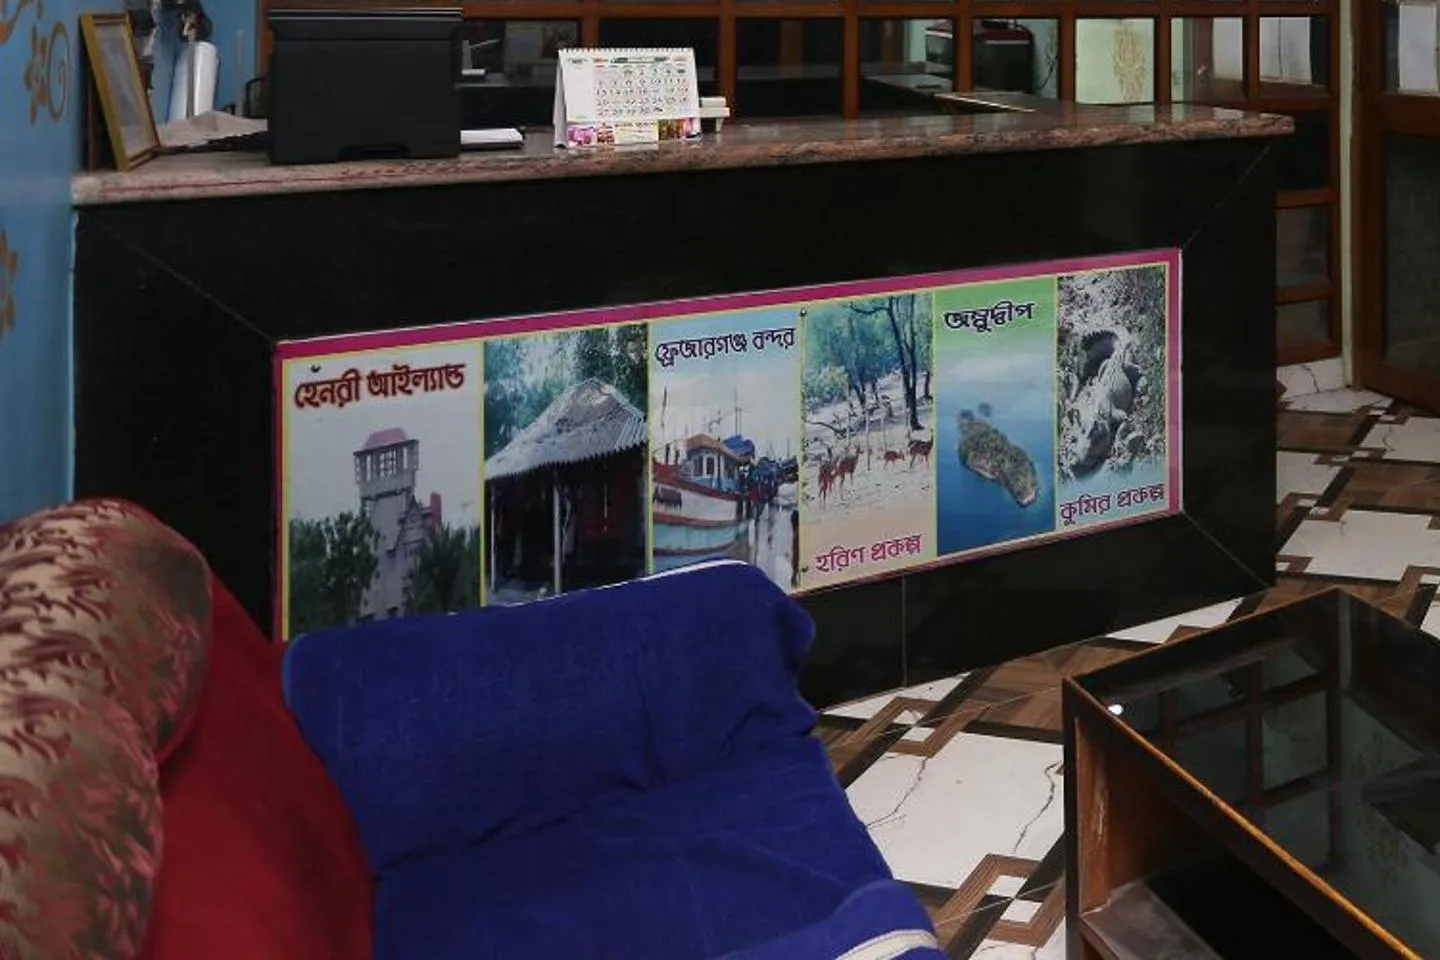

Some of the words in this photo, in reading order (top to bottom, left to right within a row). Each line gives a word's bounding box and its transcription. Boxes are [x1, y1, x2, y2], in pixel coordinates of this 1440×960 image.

[752, 327, 796, 350] বন্দর
[294, 367, 362, 409] হেনরী
[1059, 492, 1112, 527] কুমির
[815, 545, 866, 573] হরিণ
